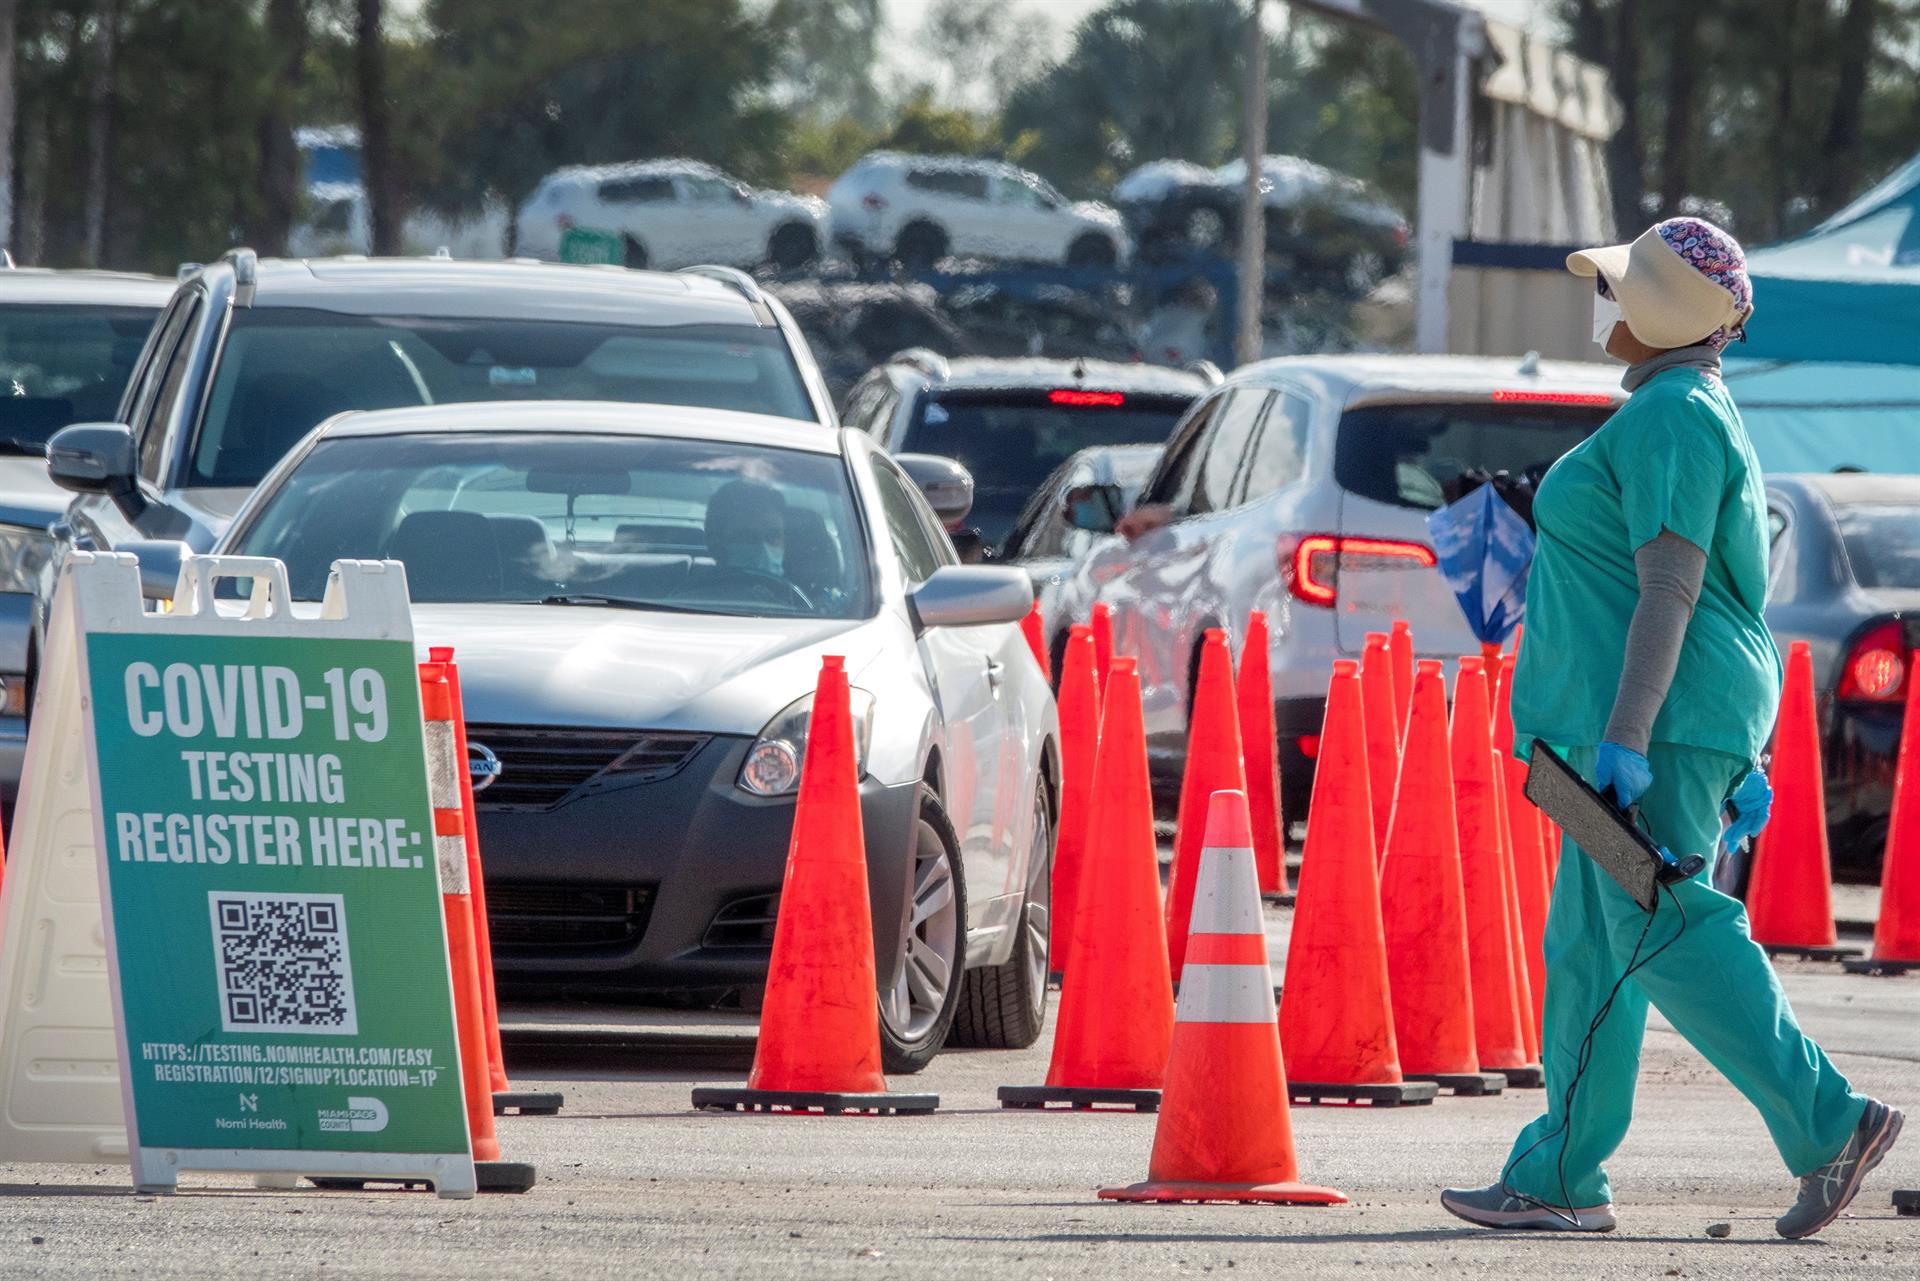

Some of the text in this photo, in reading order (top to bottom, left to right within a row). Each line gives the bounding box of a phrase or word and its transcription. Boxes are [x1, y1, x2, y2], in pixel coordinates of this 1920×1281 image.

[124, 661, 390, 742] COVID-19
[181, 750, 345, 804] TESTING
[116, 813, 424, 869] REGISTER HERE:
[142, 1042, 447, 1069] HTTPS://TESTING.NOMIHEALTH.COM/EASY_
[155, 1064, 438, 1087] REGISTRATION/12/SIGNUP?LOCATION=TP
[216, 1118, 287, 1130] Nomi Health
[320, 1119, 351, 1130] COUNTY
